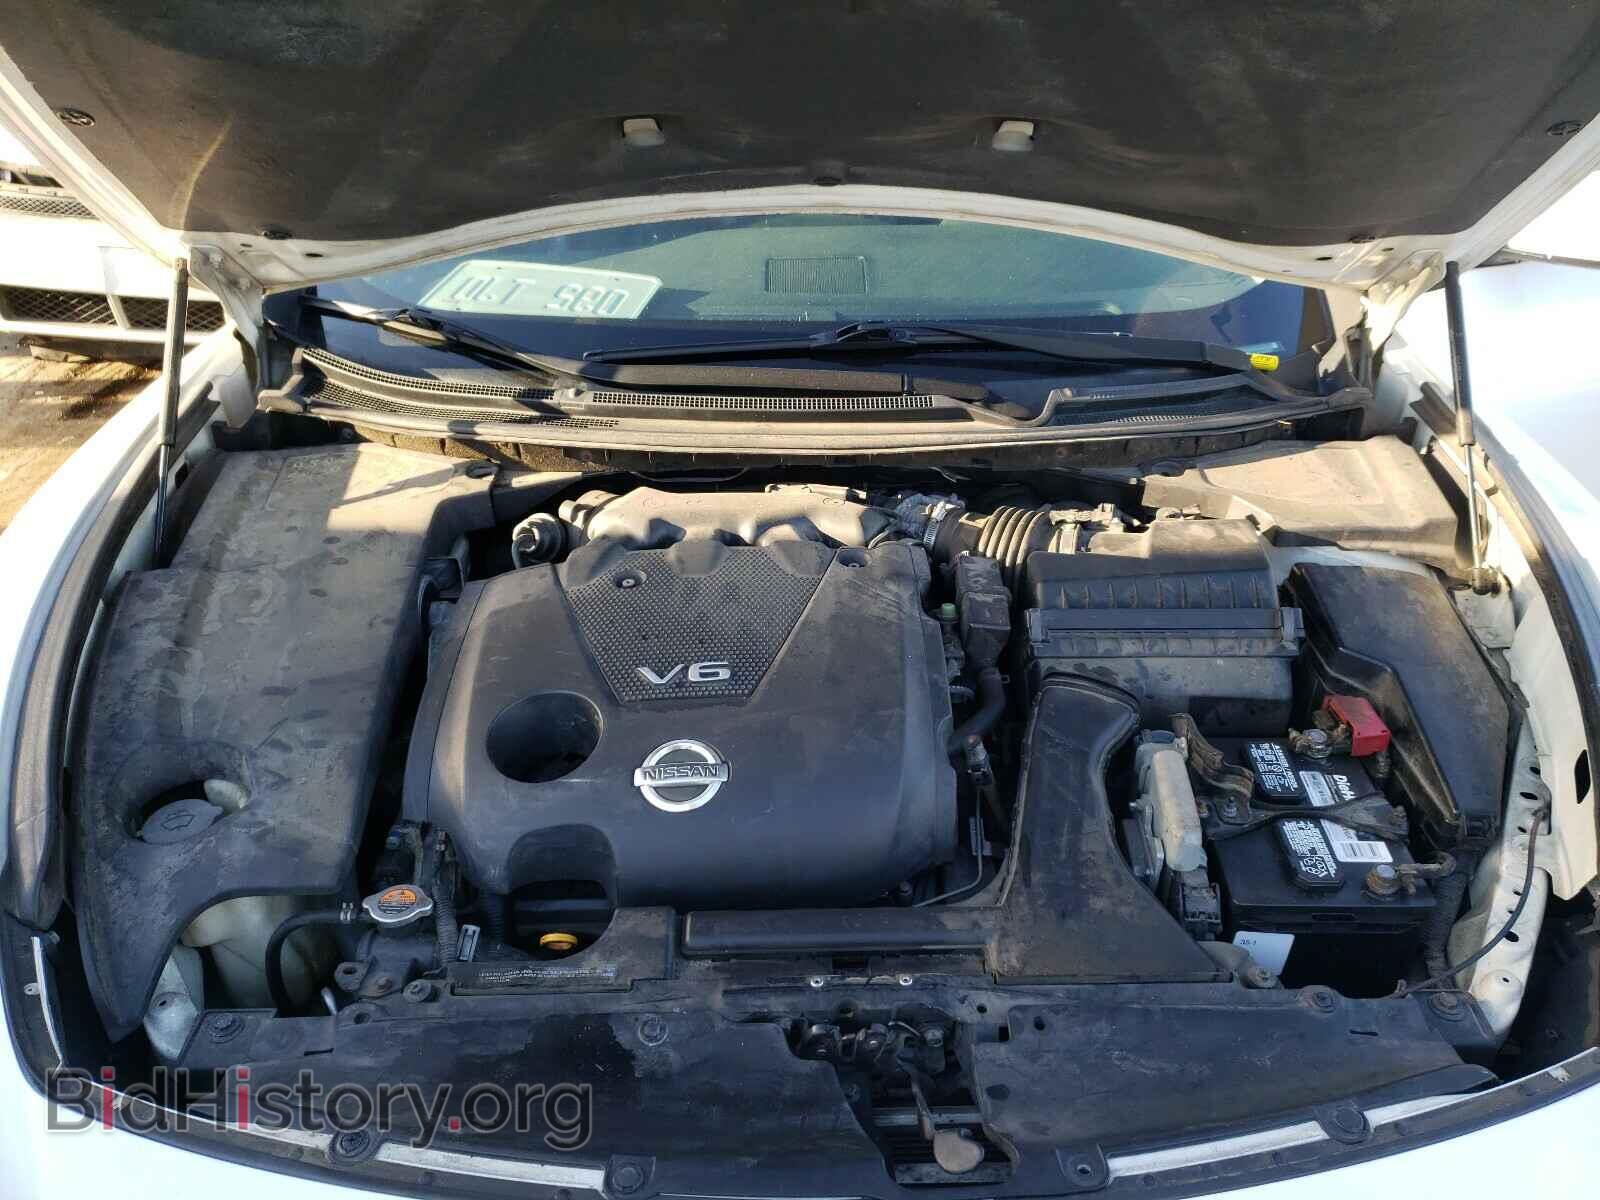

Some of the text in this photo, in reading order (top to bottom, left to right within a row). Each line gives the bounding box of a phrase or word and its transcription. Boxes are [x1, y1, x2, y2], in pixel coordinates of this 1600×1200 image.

[635, 662, 731, 685] V6
[641, 764, 720, 781] NISSAN
[1333, 774, 1358, 800] DieH
